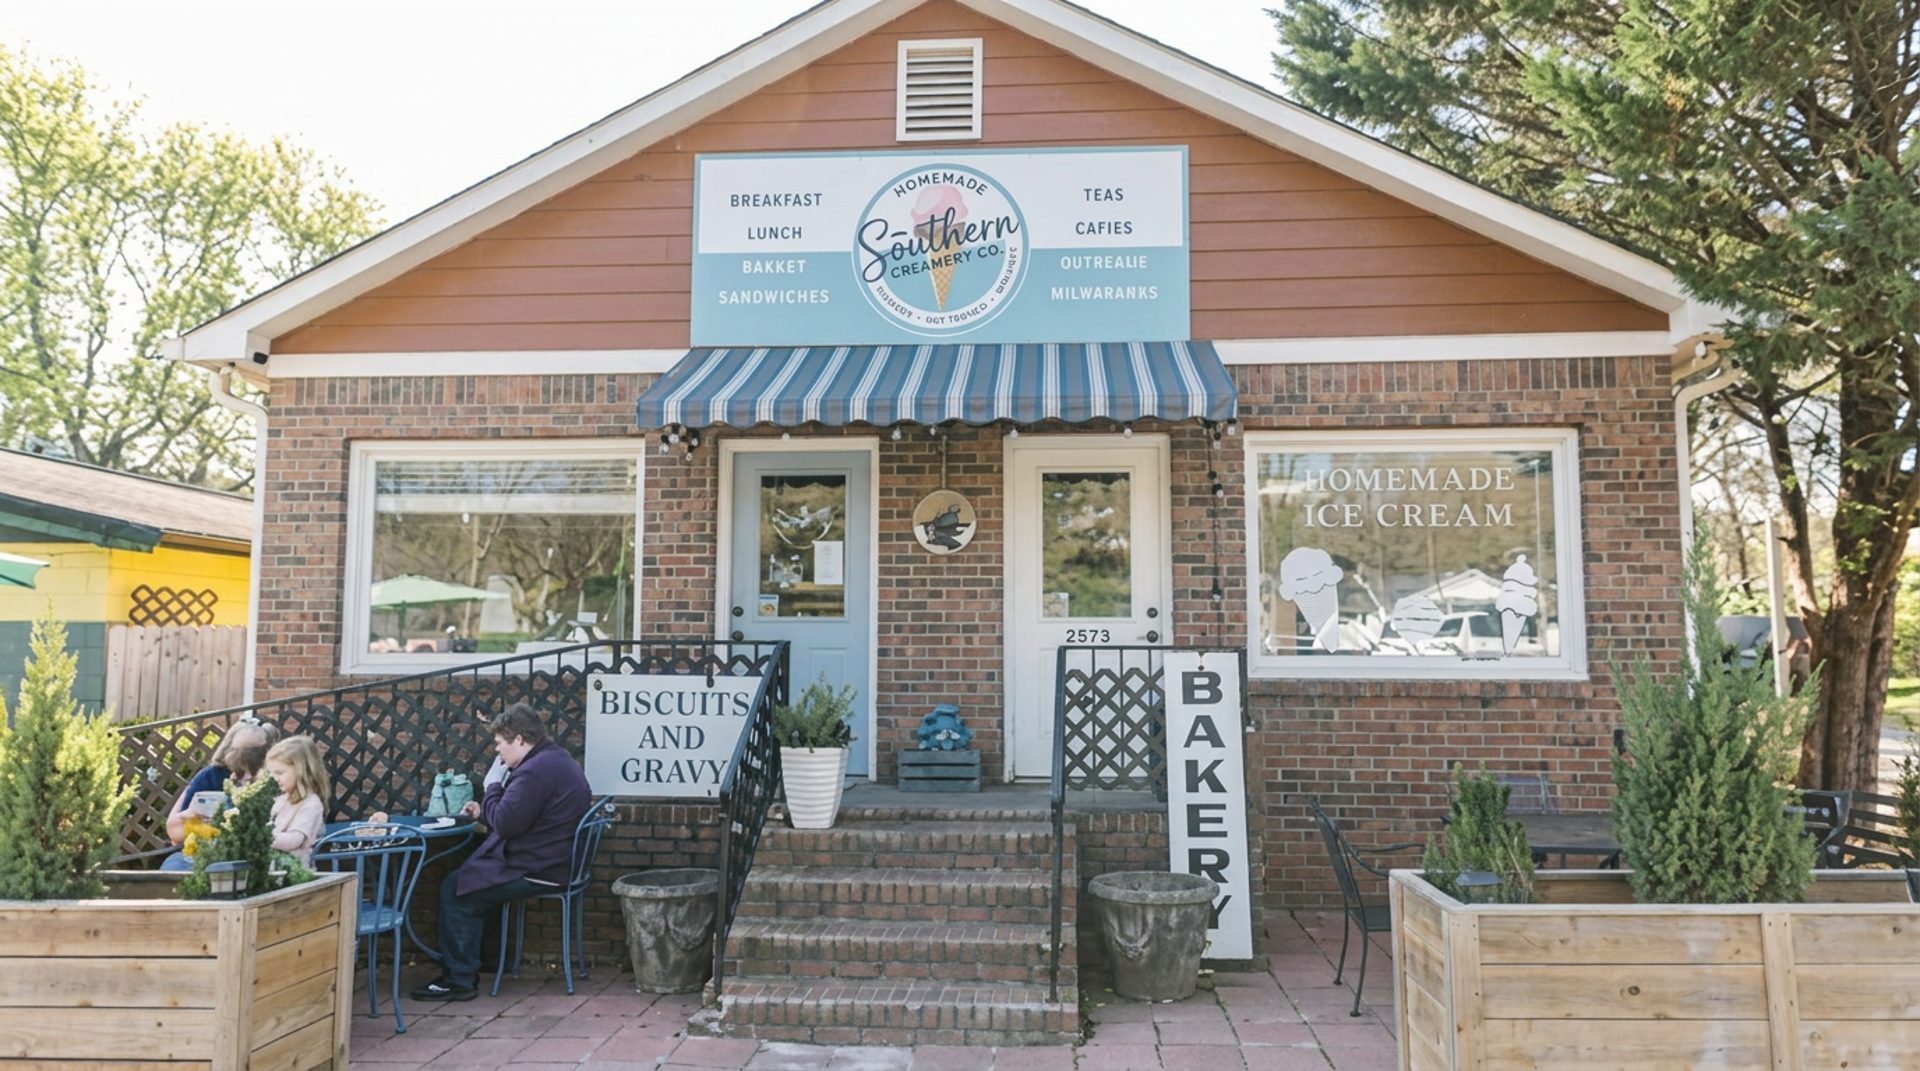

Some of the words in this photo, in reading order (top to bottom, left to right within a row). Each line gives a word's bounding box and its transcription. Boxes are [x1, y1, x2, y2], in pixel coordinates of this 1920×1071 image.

[893, 172, 988, 198] HOMEMADE
[730, 193, 823, 207] BREAKFAST
[1083, 188, 1124, 202] TEAS
[747, 226, 802, 240] LUNCH
[1075, 221, 1133, 235] CAFIES
[742, 260, 806, 274] BAKKET
[891, 250, 973, 279] CREAMERY
[977, 244, 1005, 260] CO.
[718, 289, 830, 305] SANDWICHES
[1051, 286, 1158, 300] MILWARANKS
[1304, 467, 1515, 492] HOMEMADE
[1303, 503, 1363, 528] ICE
[1375, 503, 1514, 528] CREAM
[1065, 629, 1110, 644] 2573
[600, 690, 749, 716] BISCUITS
[638, 725, 705, 750] AND
[621, 758, 728, 784] GRAVY
